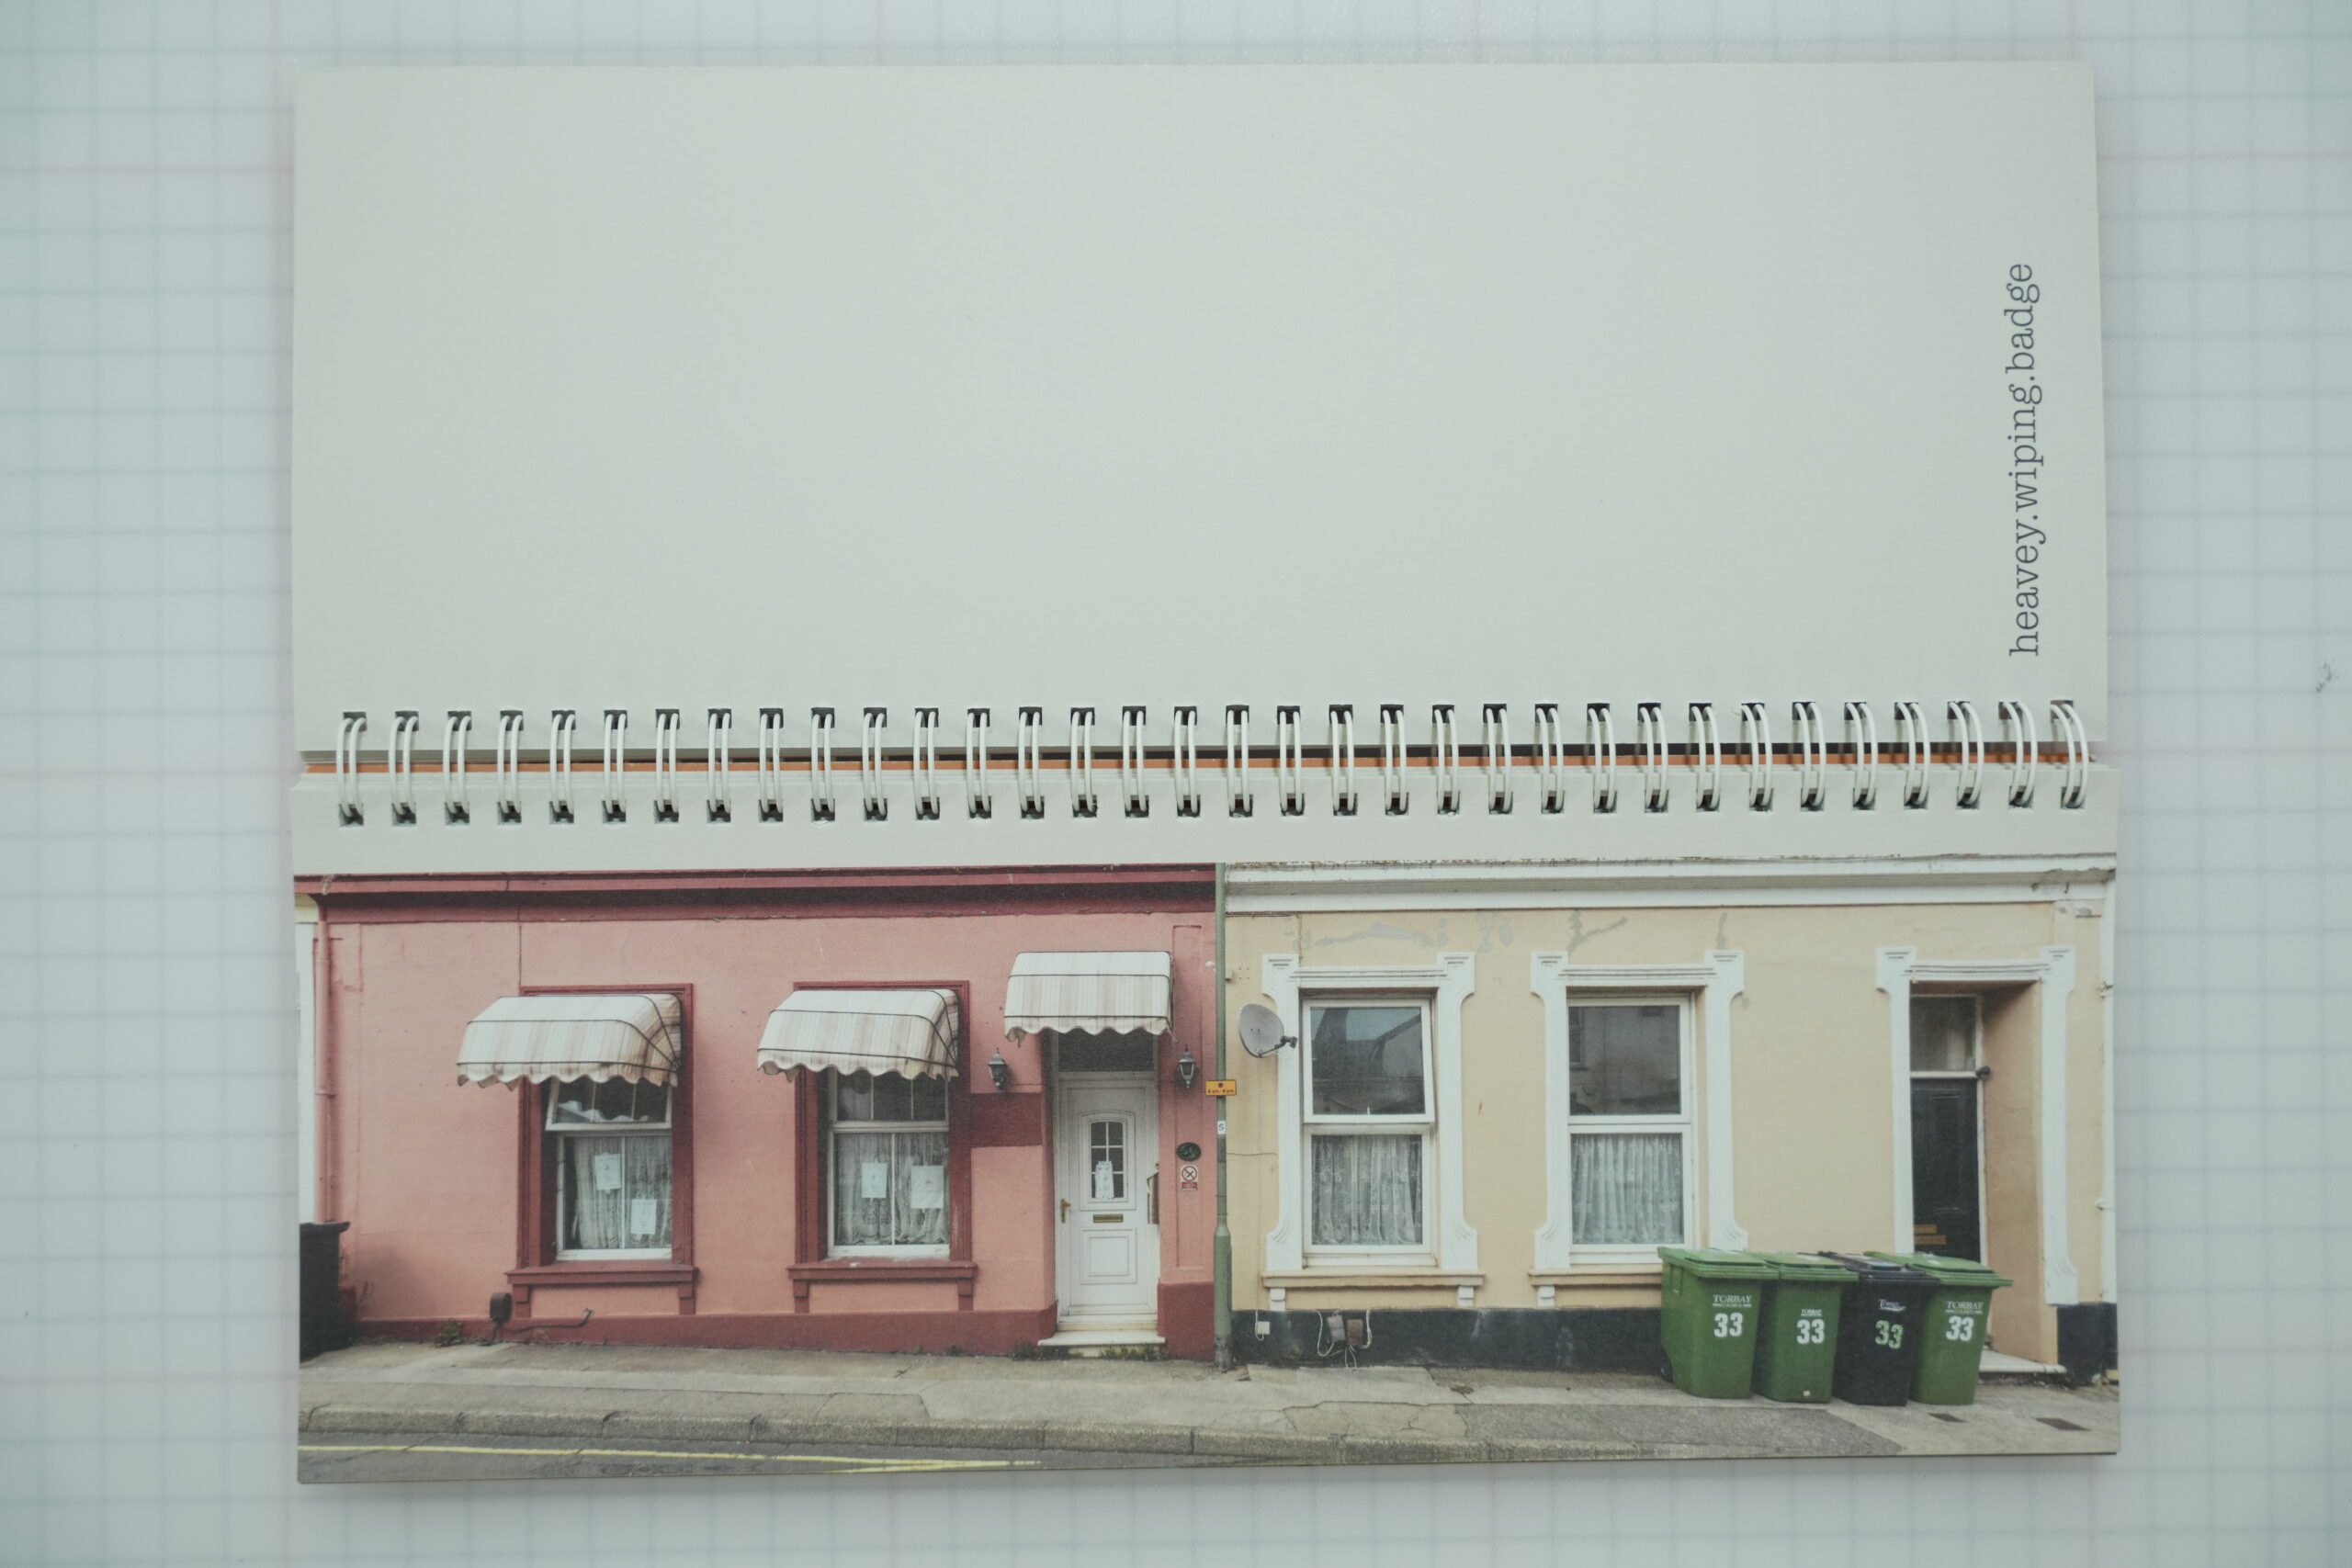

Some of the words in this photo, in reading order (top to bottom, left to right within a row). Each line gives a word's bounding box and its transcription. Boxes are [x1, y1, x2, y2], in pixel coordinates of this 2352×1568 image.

[2004, 263, 2046, 657] heavey.wiping.badge
[1713, 1293, 1753, 1303] TORBAY
[1713, 1312, 1743, 1337] 33
[1796, 1318, 1825, 1344] 33
[1874, 1320, 1904, 1348] 33
[1945, 1315, 1974, 1341] 33
